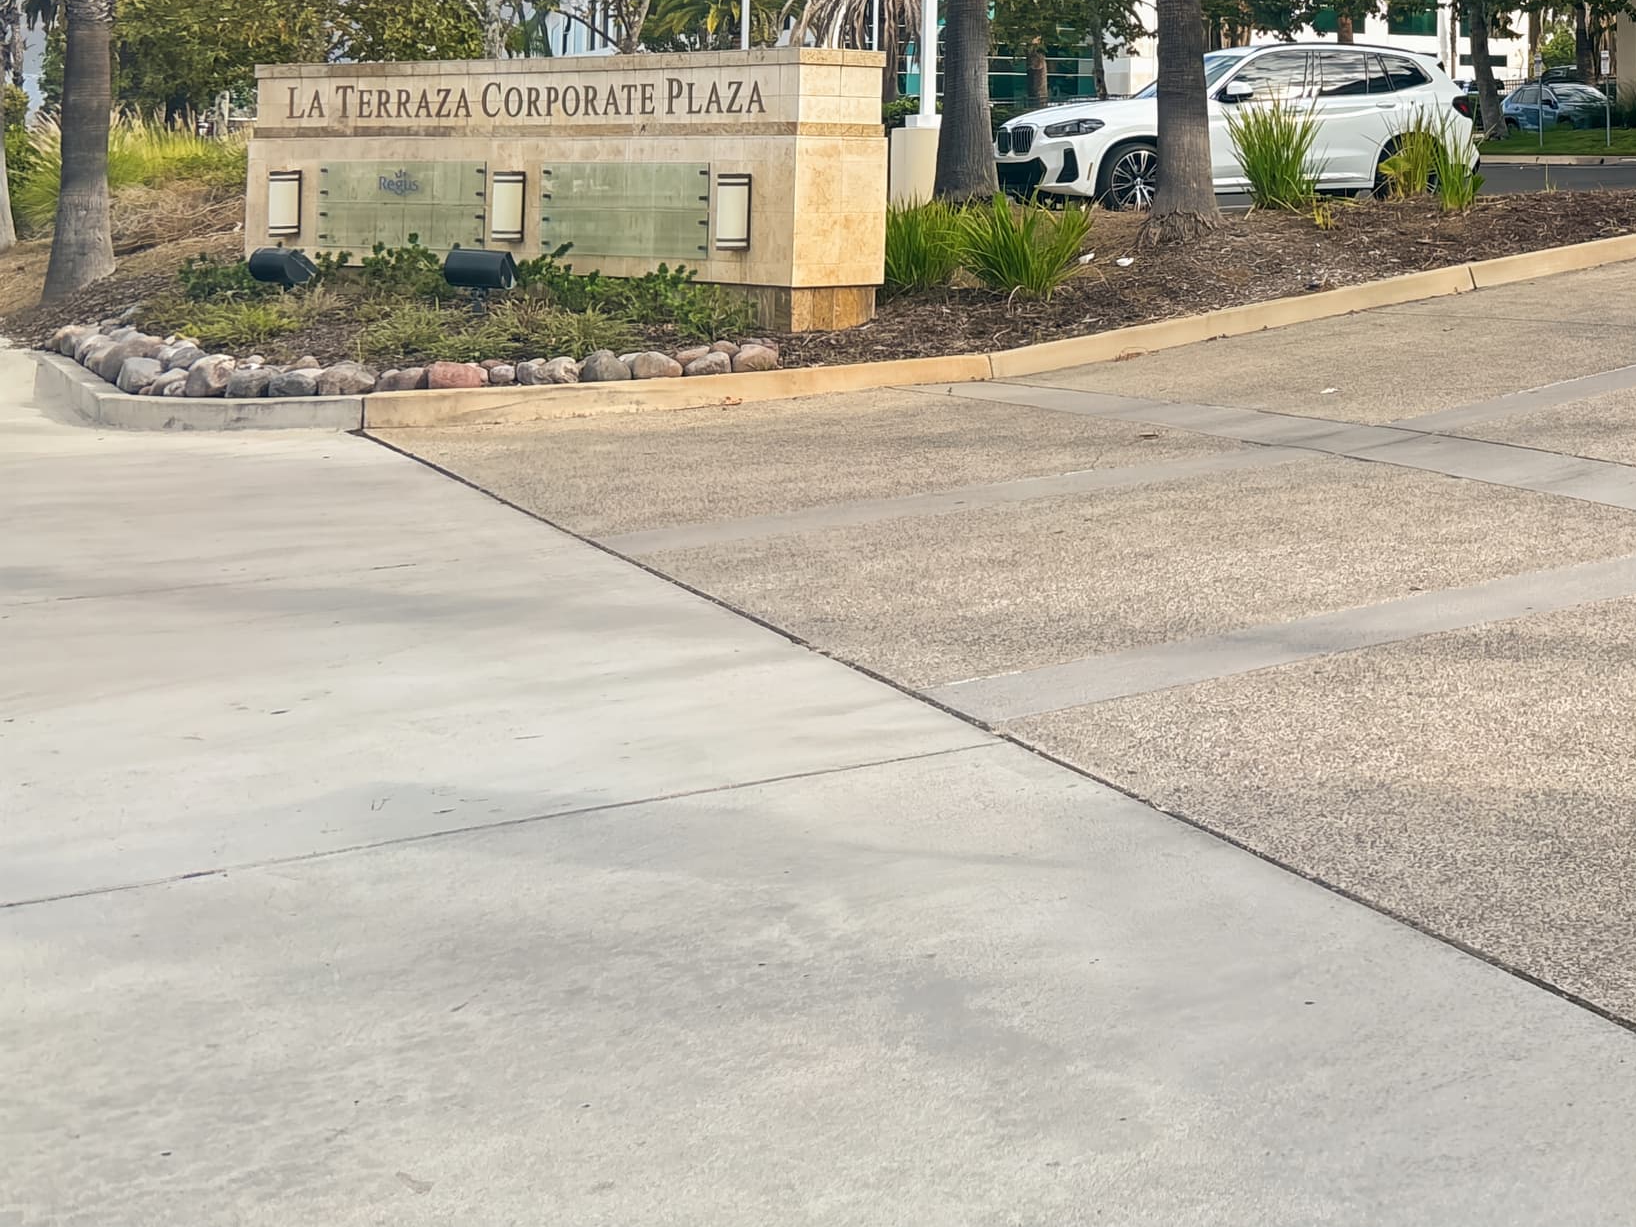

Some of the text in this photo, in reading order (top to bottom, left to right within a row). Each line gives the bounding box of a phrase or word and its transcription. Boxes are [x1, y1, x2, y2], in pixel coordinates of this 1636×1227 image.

[286, 77, 767, 120] LA TERRAZA CORPORATE PLAZA
[379, 175, 420, 196] Regus
